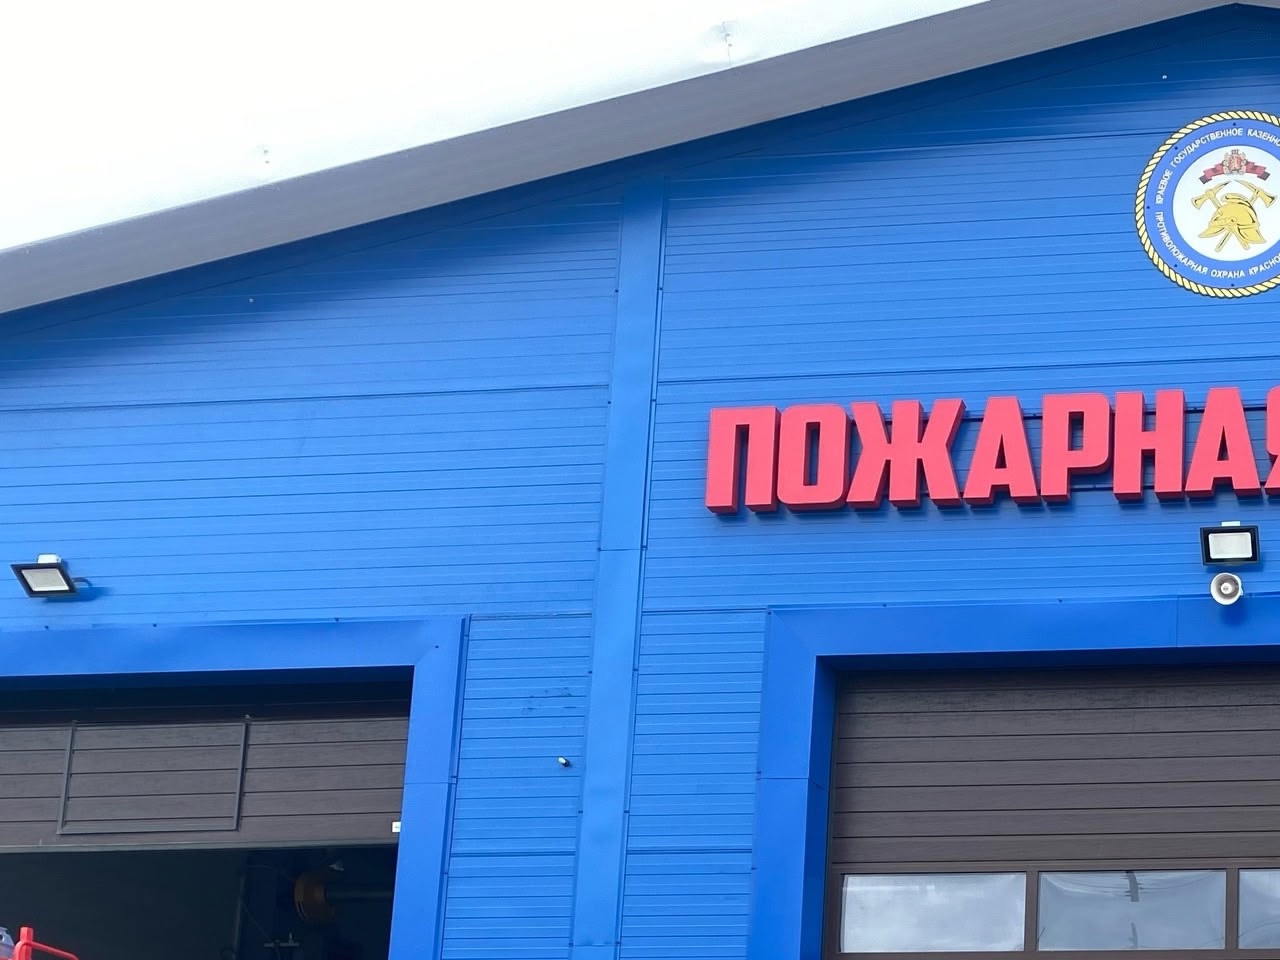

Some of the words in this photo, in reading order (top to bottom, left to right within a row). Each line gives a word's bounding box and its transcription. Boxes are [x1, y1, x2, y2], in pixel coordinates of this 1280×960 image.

[1156, 169, 1173, 204] КРАЕВОЕ
[1171, 128, 1243, 168] ГОСУДАРСТВЕННОЕ
[1155, 211, 1208, 275] ПРОТИВОПОЖАРНАЯ
[1210, 269, 1245, 279] ОХРАНА
